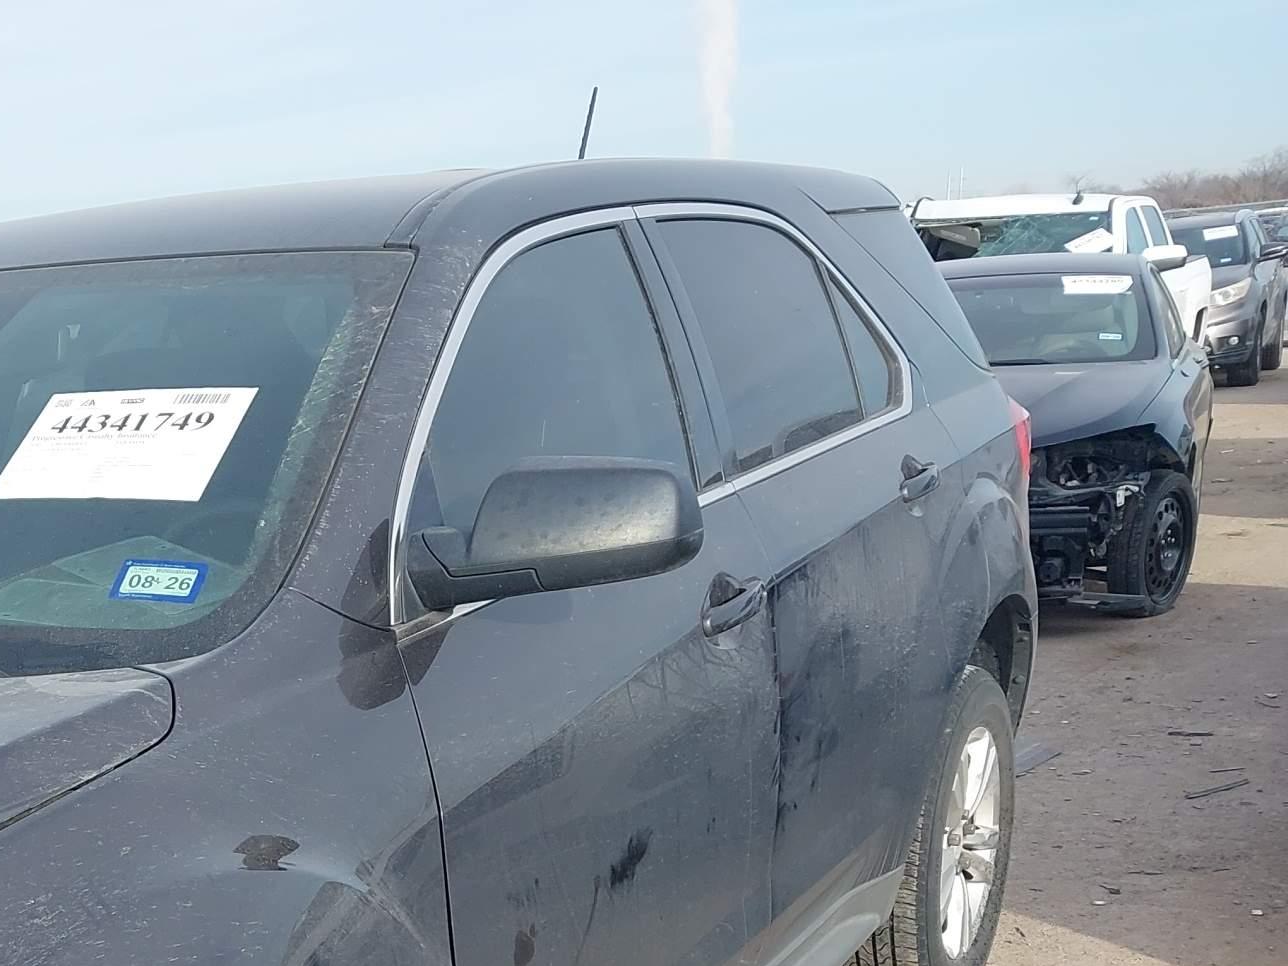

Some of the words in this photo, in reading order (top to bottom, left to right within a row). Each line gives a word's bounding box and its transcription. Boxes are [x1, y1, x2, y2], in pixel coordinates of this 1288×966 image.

[51, 411, 215, 434] 44341749
[128, 574, 155, 589] 08
[163, 576, 193, 591] 26
